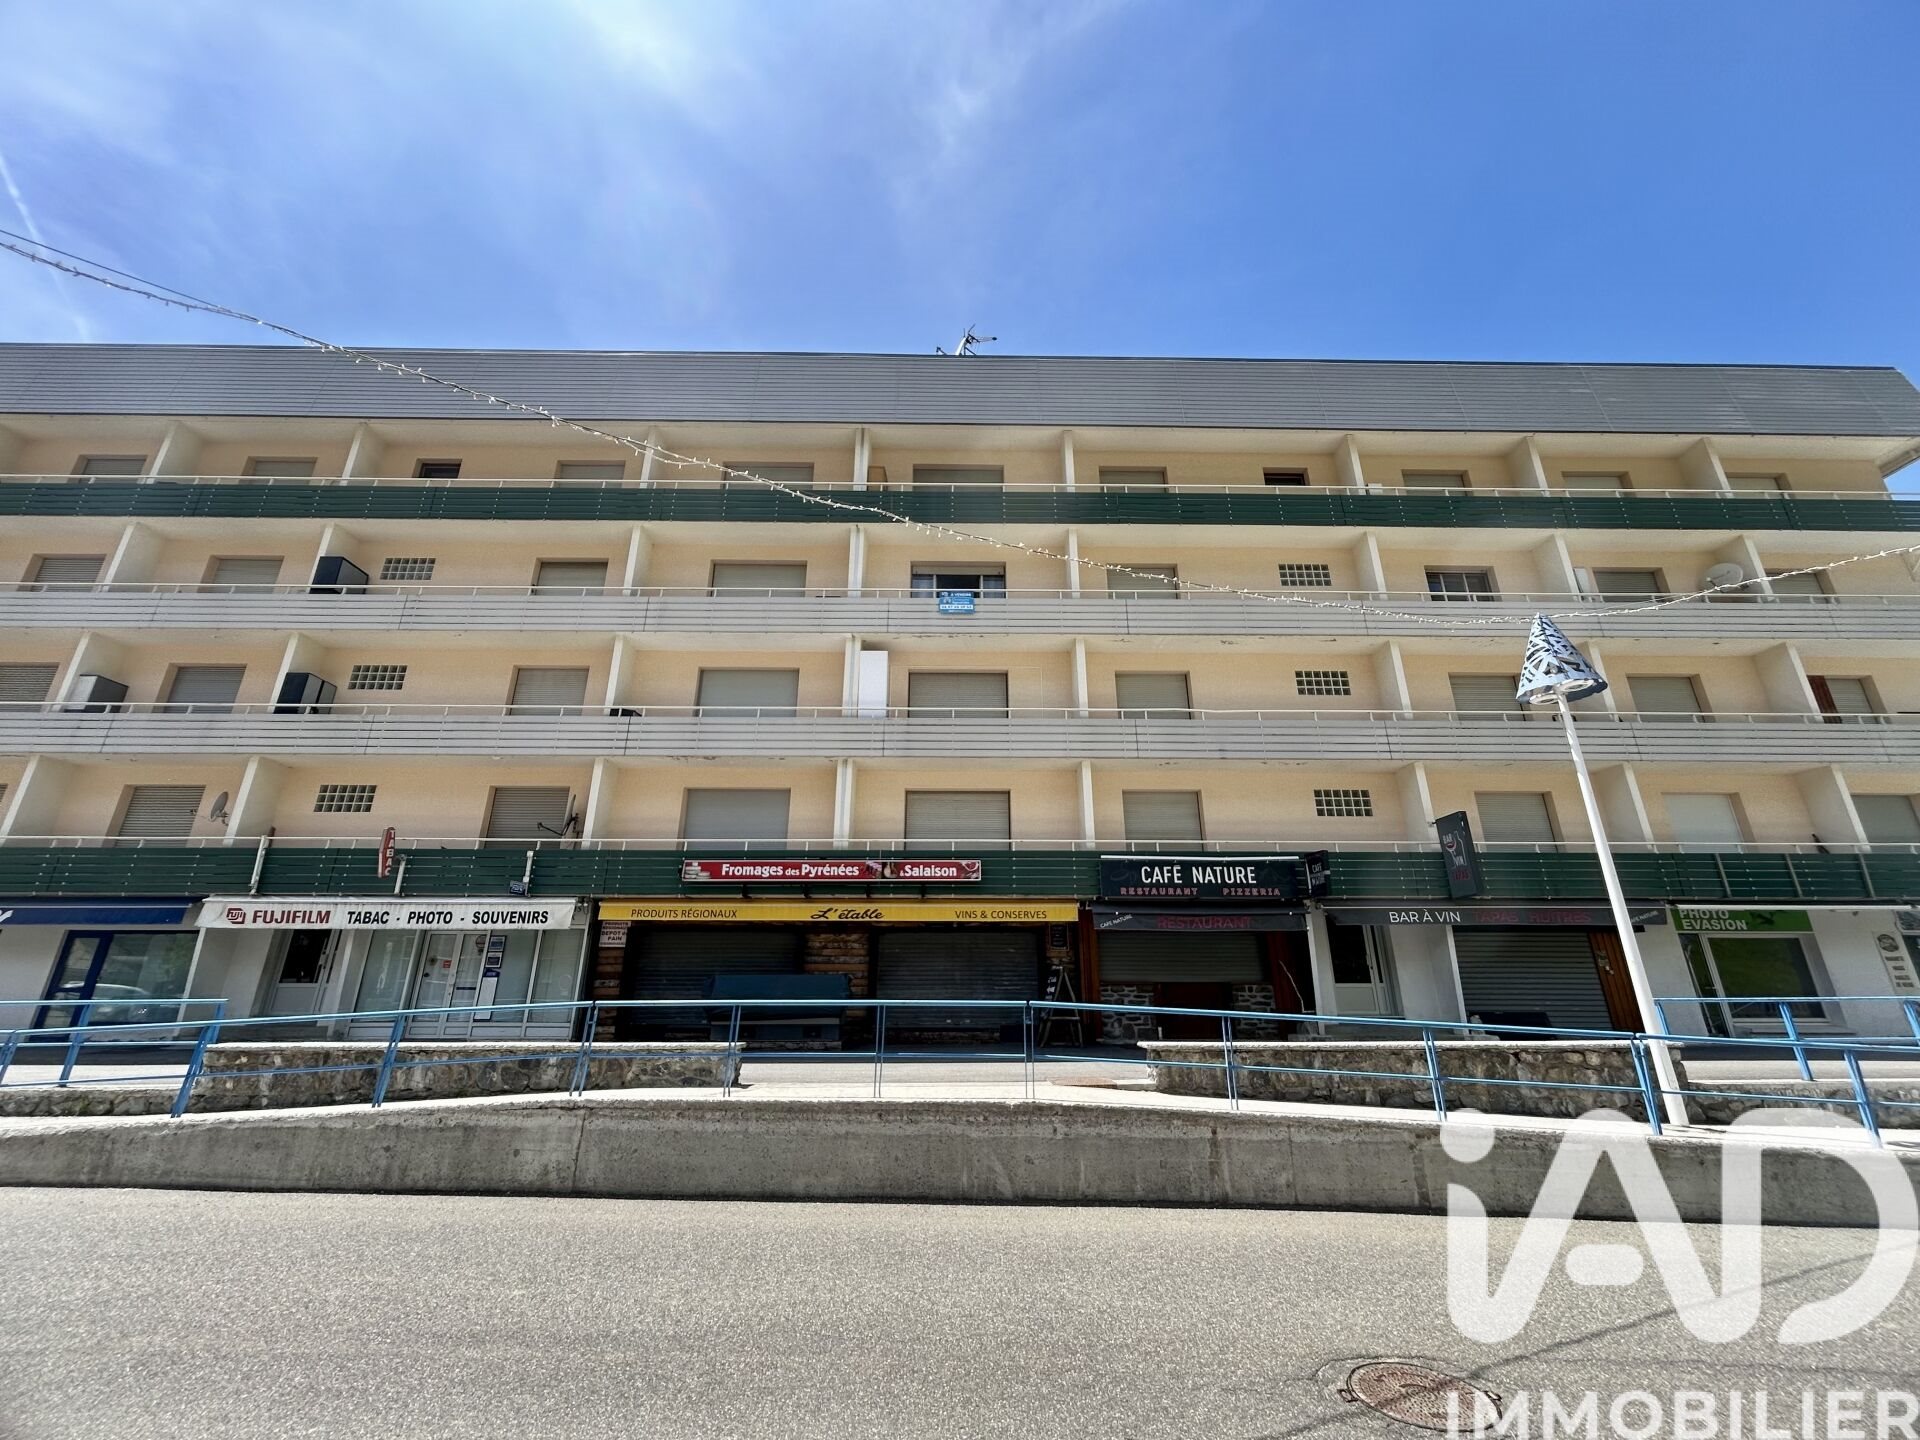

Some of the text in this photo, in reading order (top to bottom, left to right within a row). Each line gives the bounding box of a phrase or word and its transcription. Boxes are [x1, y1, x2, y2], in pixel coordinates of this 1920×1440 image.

[385, 830, 395, 876] TABAC
[722, 864, 783, 877] Fromages
[785, 865, 799, 876] des
[801, 863, 860, 878] Pyrénées
[904, 864, 957, 877] Salaison
[1141, 864, 1257, 884] CAFÉ NATURE
[1120, 887, 1281, 896] RESTAURANT PIZZERIA
[252, 910, 331, 924] FUJIFILM
[347, 911, 390, 924] TABAC
[407, 911, 453, 924] PHOTO
[472, 911, 549, 924] SOUVENIRS
[631, 906, 737, 918] PRODUITS RÉGIONAUX
[955, 910, 1047, 919] VINS & CONSERVES
[1389, 908, 1461, 923] BAR À VIN
[1472, 911, 1519, 922] TAPAS
[1680, 909, 1729, 919] PHOTO
[1157, 916, 1252, 928] RESTAURANT
[1683, 919, 1748, 931] EVASION
